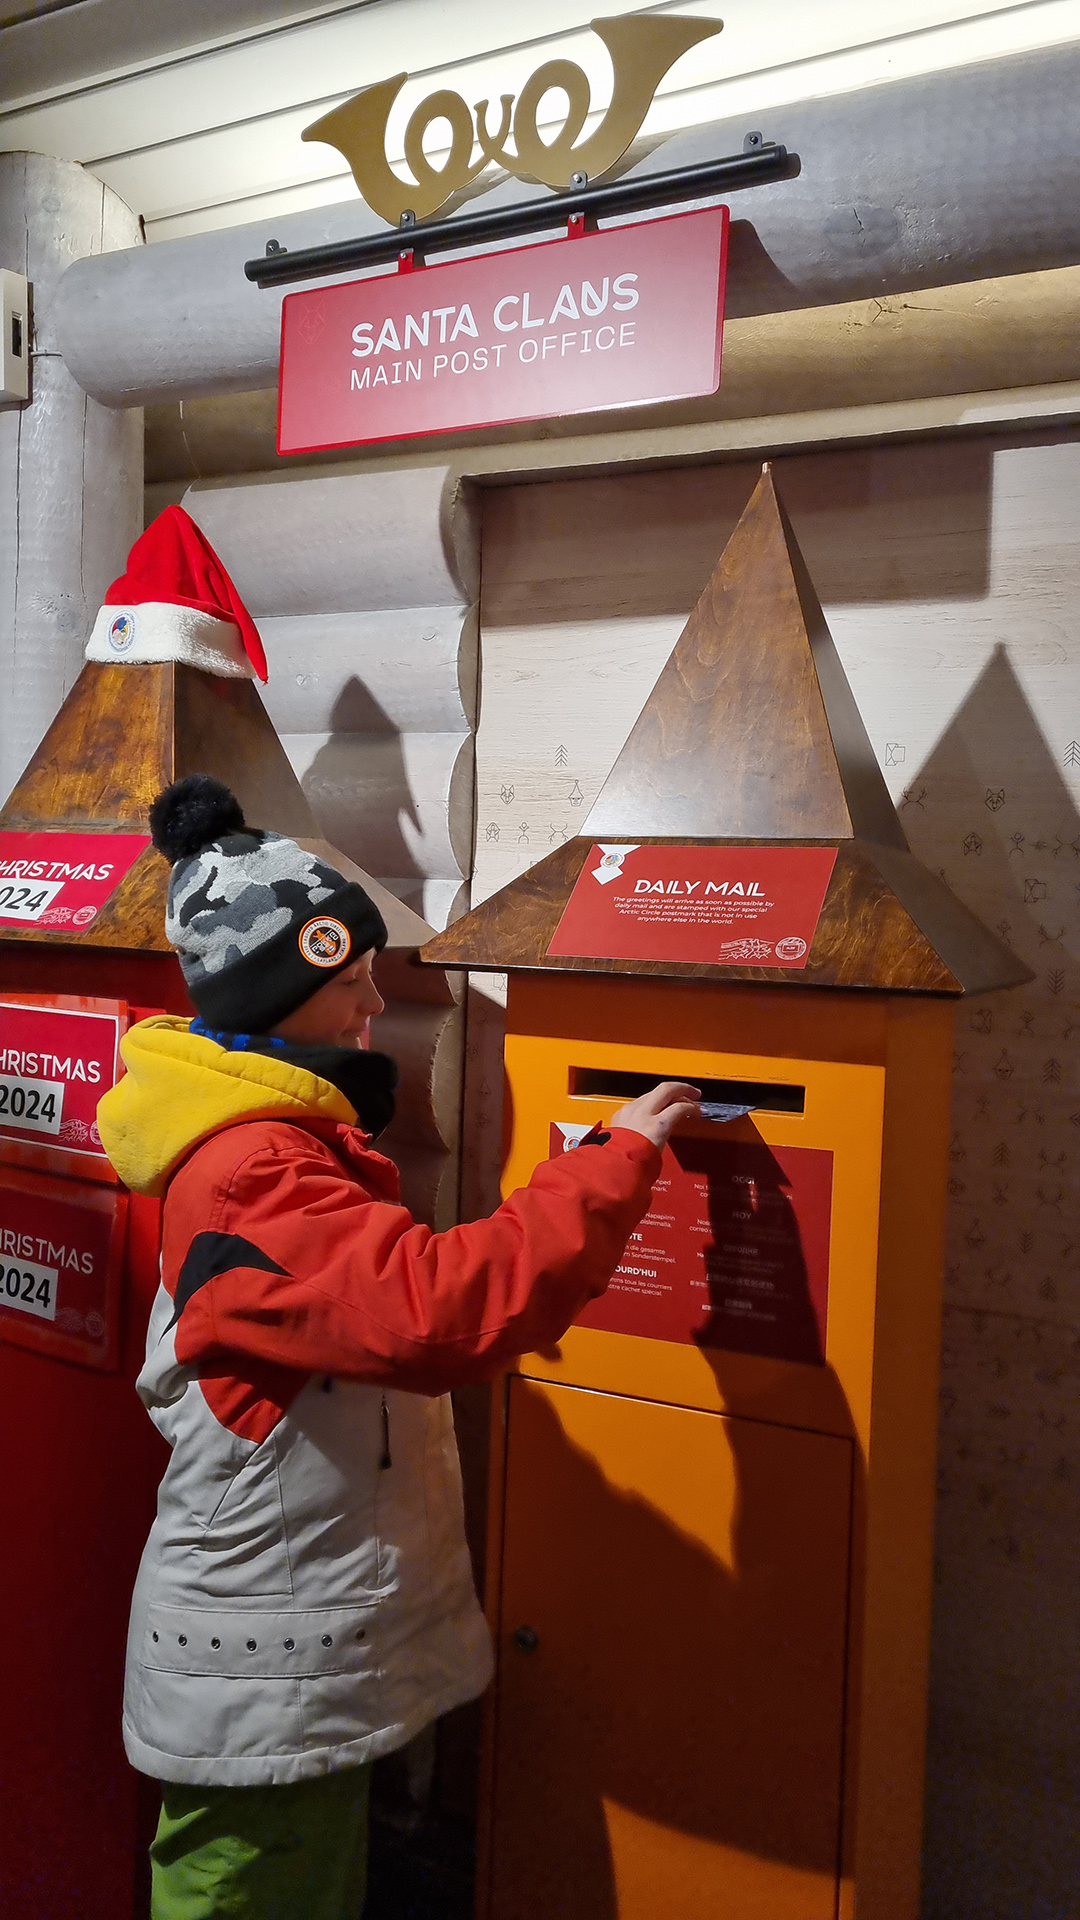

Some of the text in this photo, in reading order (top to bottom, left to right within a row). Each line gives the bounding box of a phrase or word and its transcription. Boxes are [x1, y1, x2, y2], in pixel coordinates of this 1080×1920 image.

[351, 303, 479, 357] SANTA
[351, 322, 636, 391] MAIN POST OFFICE
[0, 860, 114, 880] HRISTMAS
[634, 879, 766, 897] DAILY MAIL
[0, 1085, 56, 1123] 2024
[733, 1212, 752, 1220] HOY
[0, 1263, 51, 1308] 024
